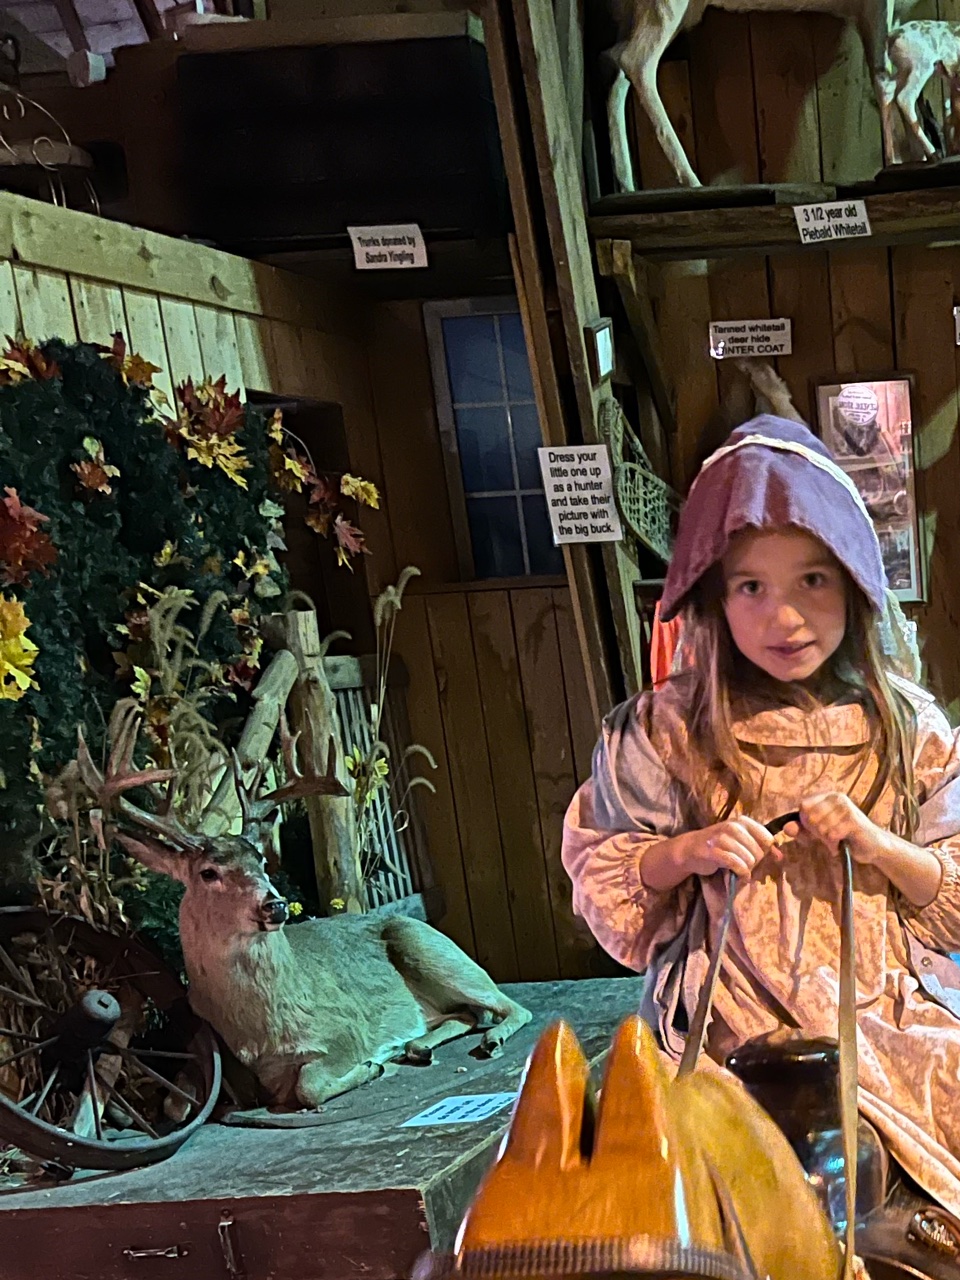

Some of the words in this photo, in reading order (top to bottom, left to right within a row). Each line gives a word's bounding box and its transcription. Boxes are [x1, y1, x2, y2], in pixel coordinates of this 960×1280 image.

[803, 208, 810, 222] 3
[811, 206, 824, 220] 1/2
[825, 207, 843, 222] year
[845, 204, 857, 217] old
[802, 225, 833, 241] Piebald
[832, 222, 868, 236] Whitetail
[713, 324, 746, 334] Tanned
[748, 323, 785, 332] whitetail
[728, 336, 748, 344] deer
[751, 334, 770, 343] hide
[715, 345, 754, 355] INTER
[757, 344, 785, 353] COAT
[548, 452, 575, 463] Dress
[577, 452, 597, 464] your
[549, 467, 568, 478] little
[571, 468, 587, 477] one
[589, 467, 601, 478] up
[553, 484, 564, 492] as
[567, 483, 572, 492] a
[574, 481, 603, 491] hunter
[551, 496, 568, 507] and
[570, 495, 589, 506] take
[591, 494, 611, 505] their
[559, 510, 588, 523] picture
[590, 509, 609, 519] with
[558, 525, 573, 535] the
[574, 524, 589, 536] big
[590, 523, 615, 533] buck.
